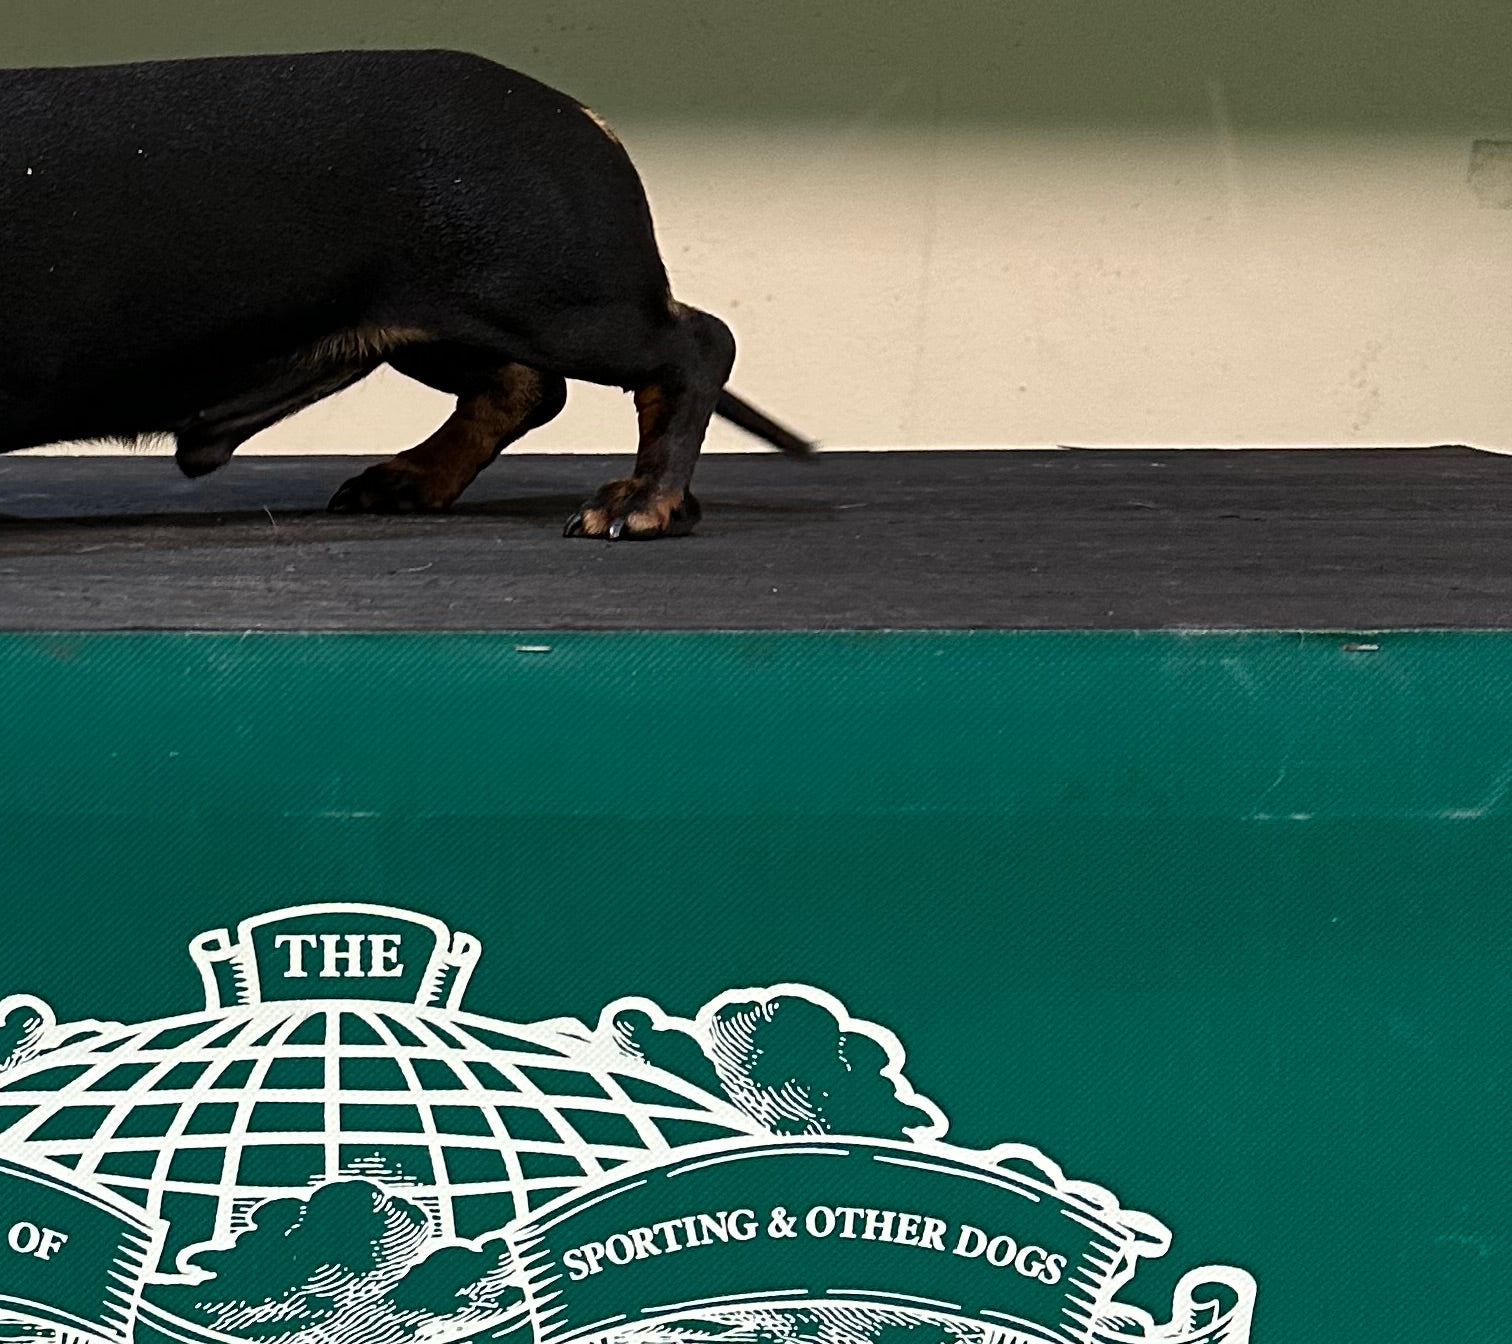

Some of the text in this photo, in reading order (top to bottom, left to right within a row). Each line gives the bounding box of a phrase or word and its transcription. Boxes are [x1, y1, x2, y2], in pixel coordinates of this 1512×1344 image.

[274, 934, 404, 978] THE
[7, 1221, 69, 1261] OF
[562, 1205, 1068, 1285] SPORTING & OTHER DOGS
